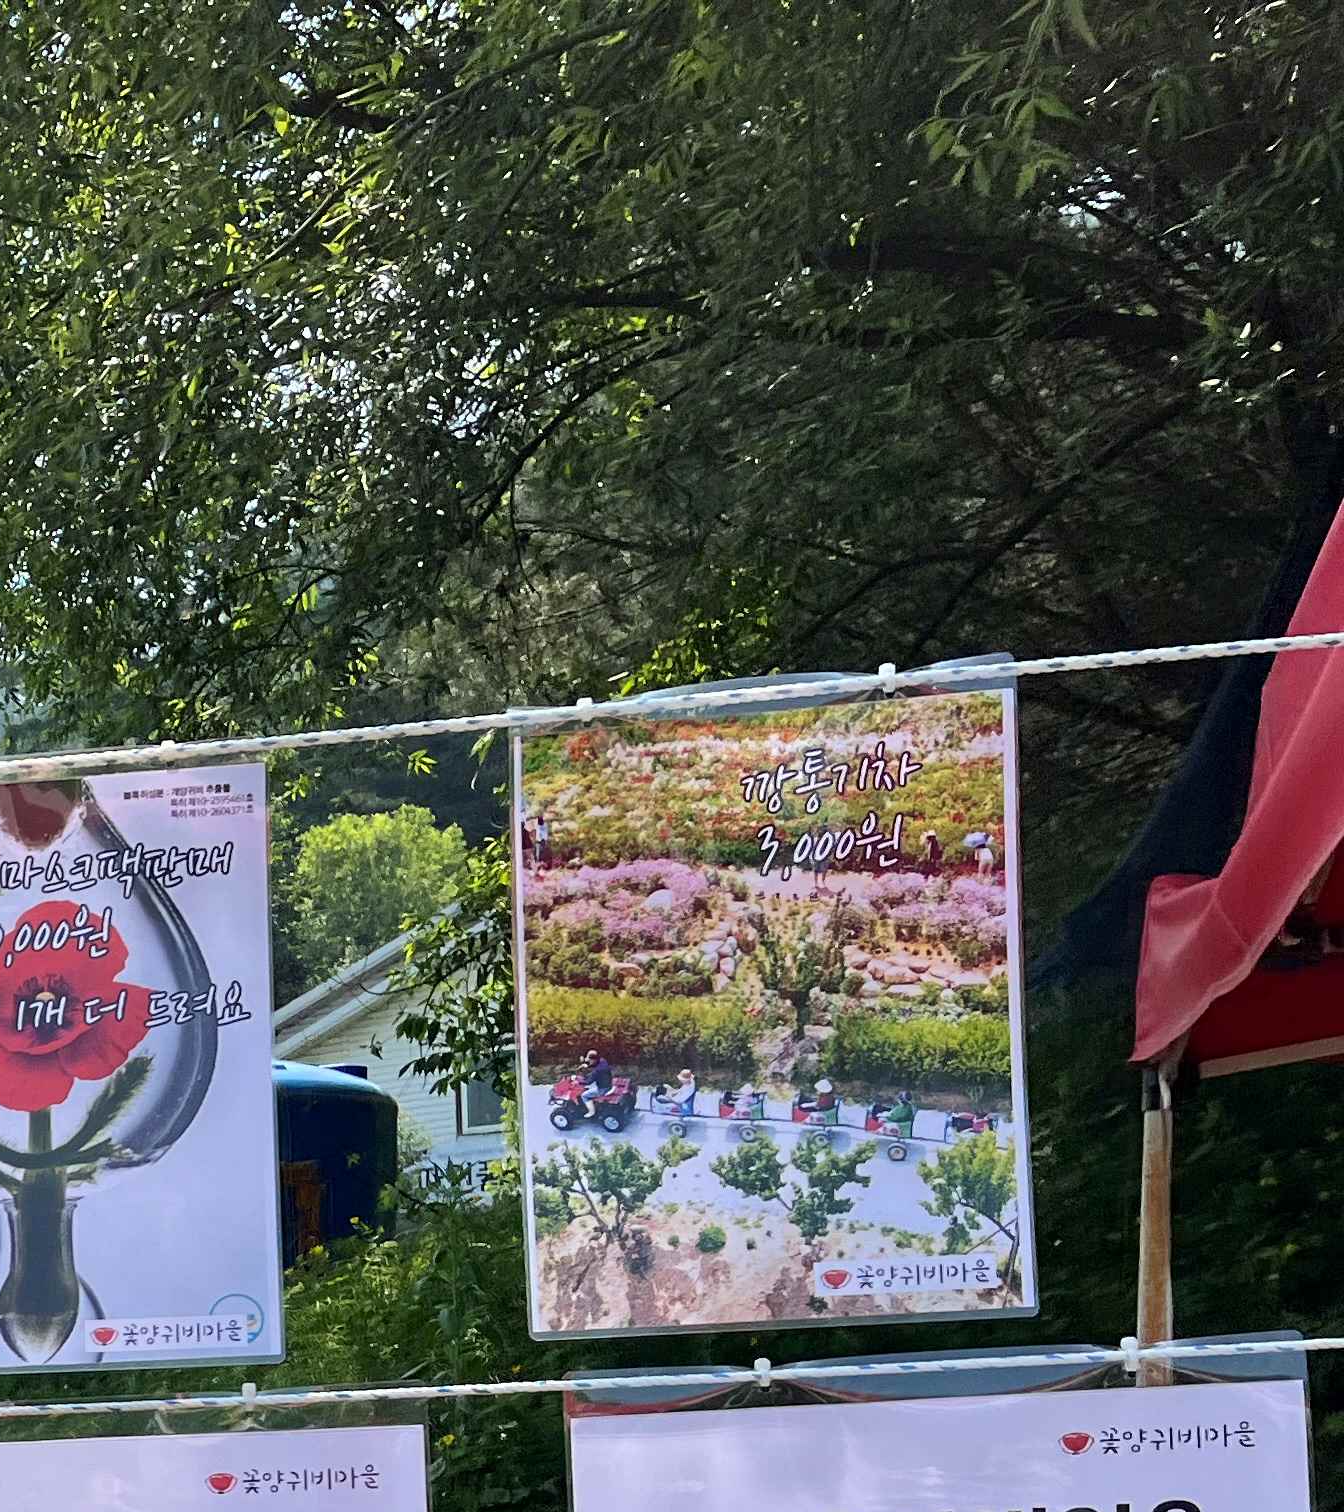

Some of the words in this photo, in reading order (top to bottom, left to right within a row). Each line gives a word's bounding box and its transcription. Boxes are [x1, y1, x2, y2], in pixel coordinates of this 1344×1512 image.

[739, 740, 923, 815] 깡통기차
[755, 811, 905, 882] 3,000원
[15, 995, 68, 1033] 1개
[84, 993, 125, 1024] 더
[144, 980, 251, 1030] 드려요
[855, 1259, 991, 1289] 꽃양귀비마을
[123, 1319, 242, 1345] 꽃양귀비마을
[1100, 1421, 1256, 1455] 꽃양귀비마을
[242, 1464, 380, 1495] 꽃양귀비마을
